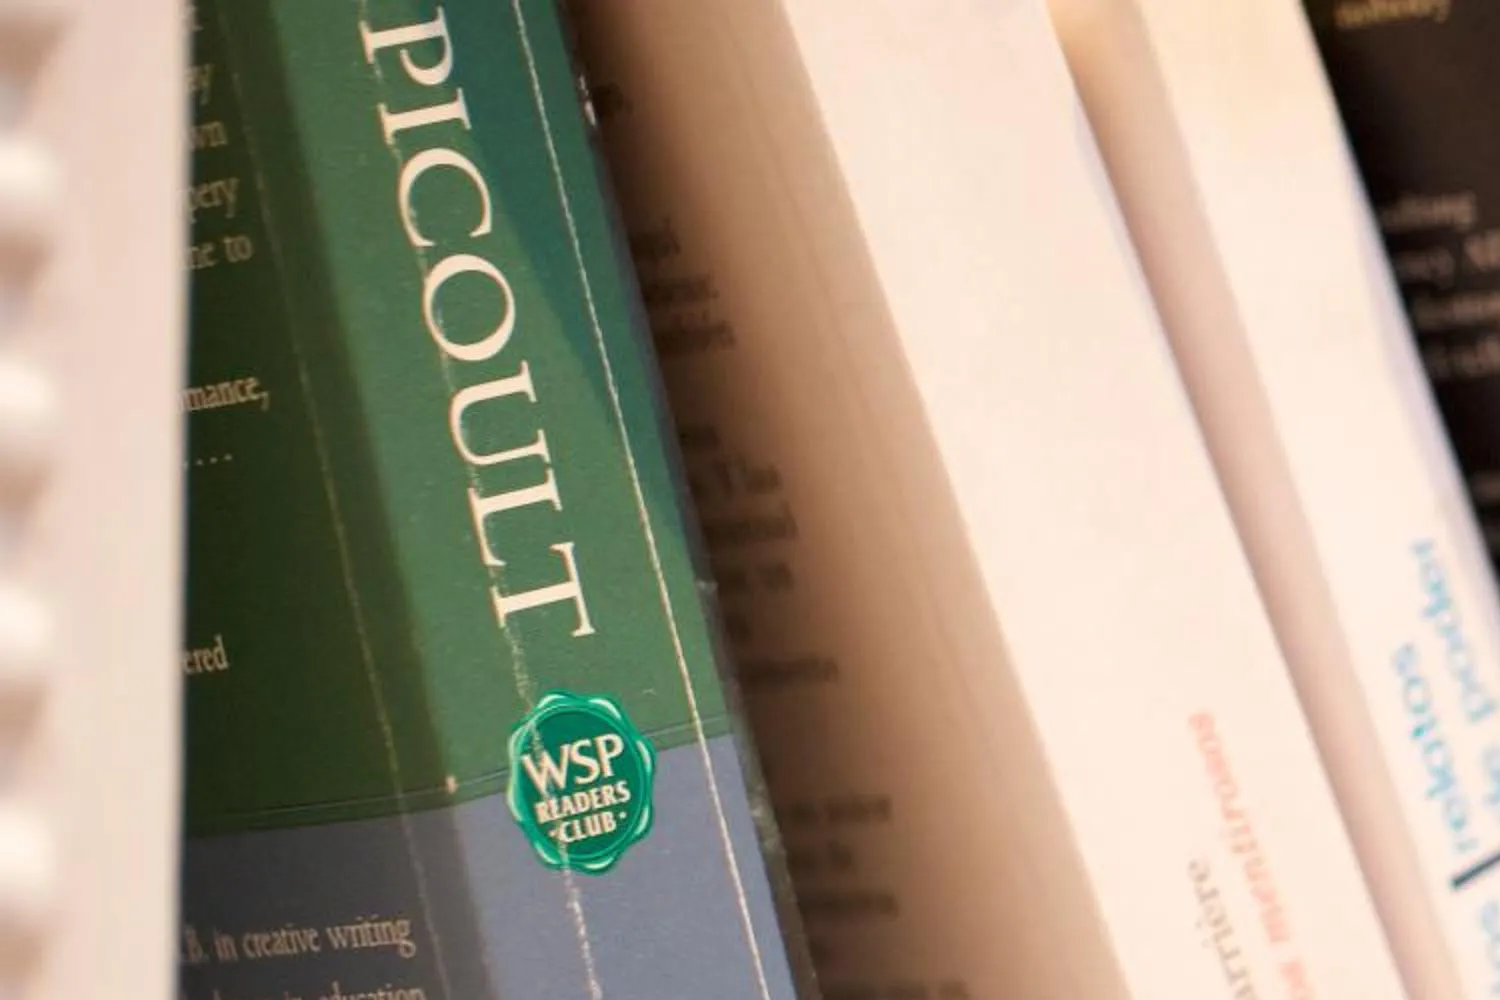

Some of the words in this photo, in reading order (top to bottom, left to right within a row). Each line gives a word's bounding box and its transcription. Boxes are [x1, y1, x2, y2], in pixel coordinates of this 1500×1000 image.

[360, 7, 596, 638] PICOULT
[521, 733, 625, 797] WSP
[1392, 643, 1478, 853] relatos
[533, 780, 632, 824] READERS
[214, 926, 239, 962] in
[243, 923, 321, 958] creative
[326, 914, 417, 958] writing
